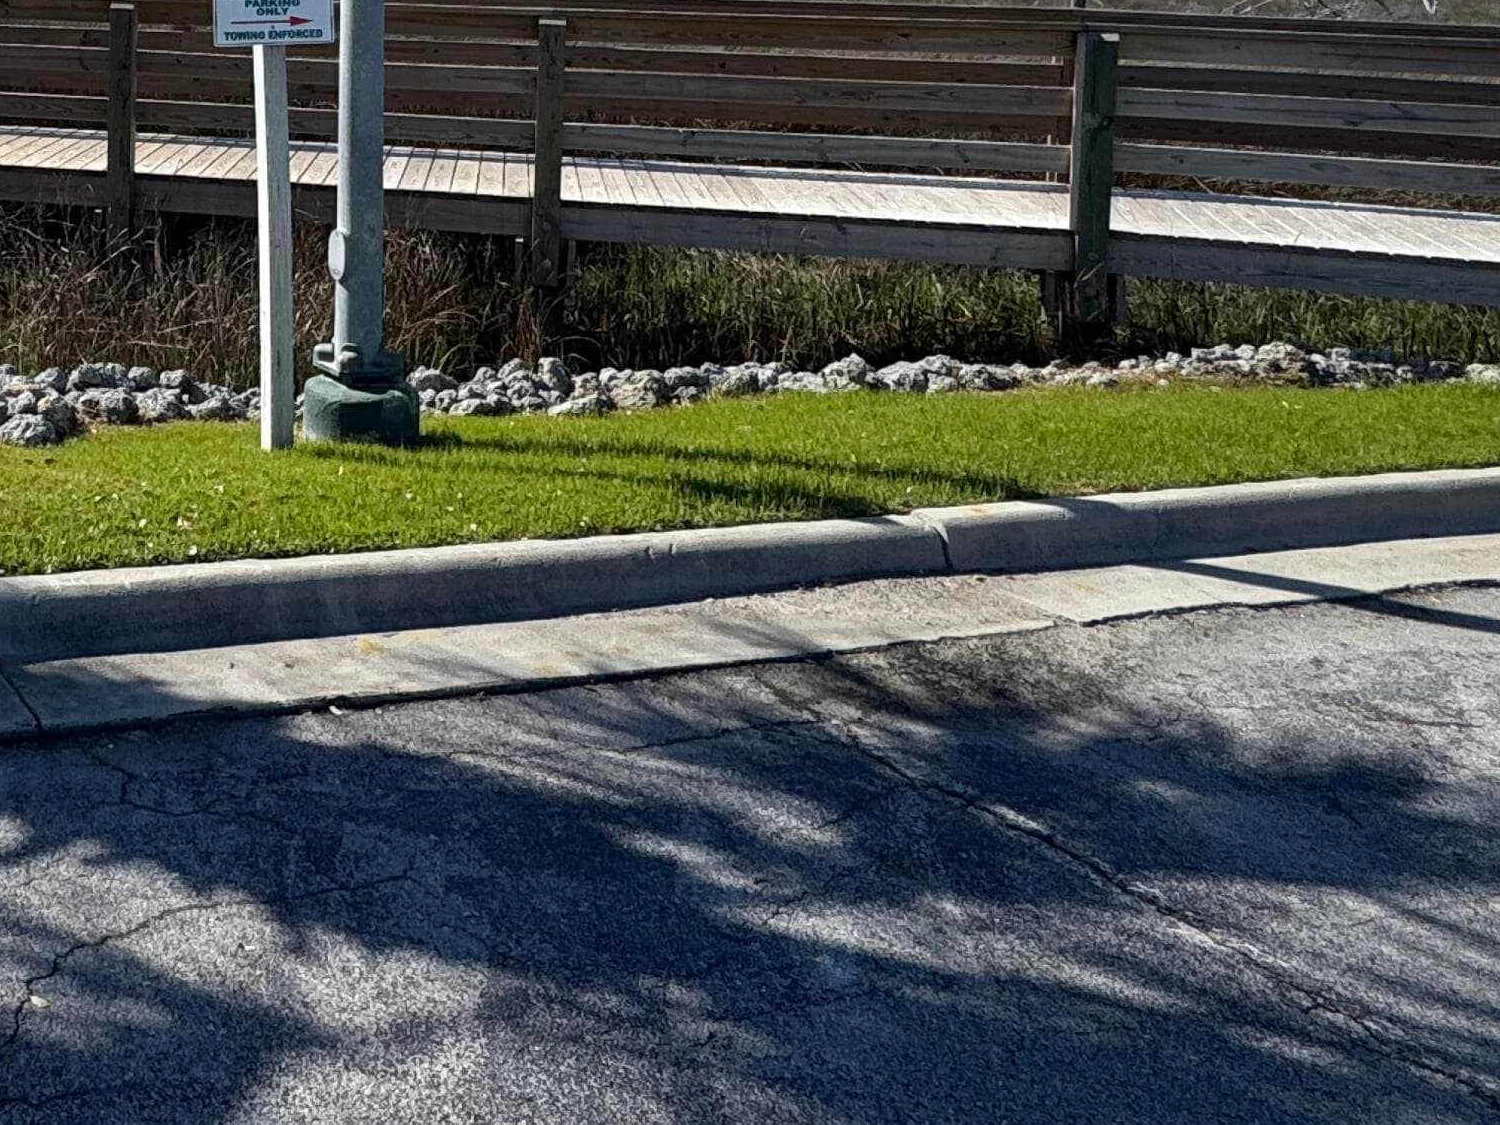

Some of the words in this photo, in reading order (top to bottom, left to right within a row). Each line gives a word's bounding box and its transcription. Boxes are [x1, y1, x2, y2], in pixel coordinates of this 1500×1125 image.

[256, 8, 289, 16] ONLY
[224, 31, 266, 41] TOWING
[268, 29, 323, 39] ENFORCED
